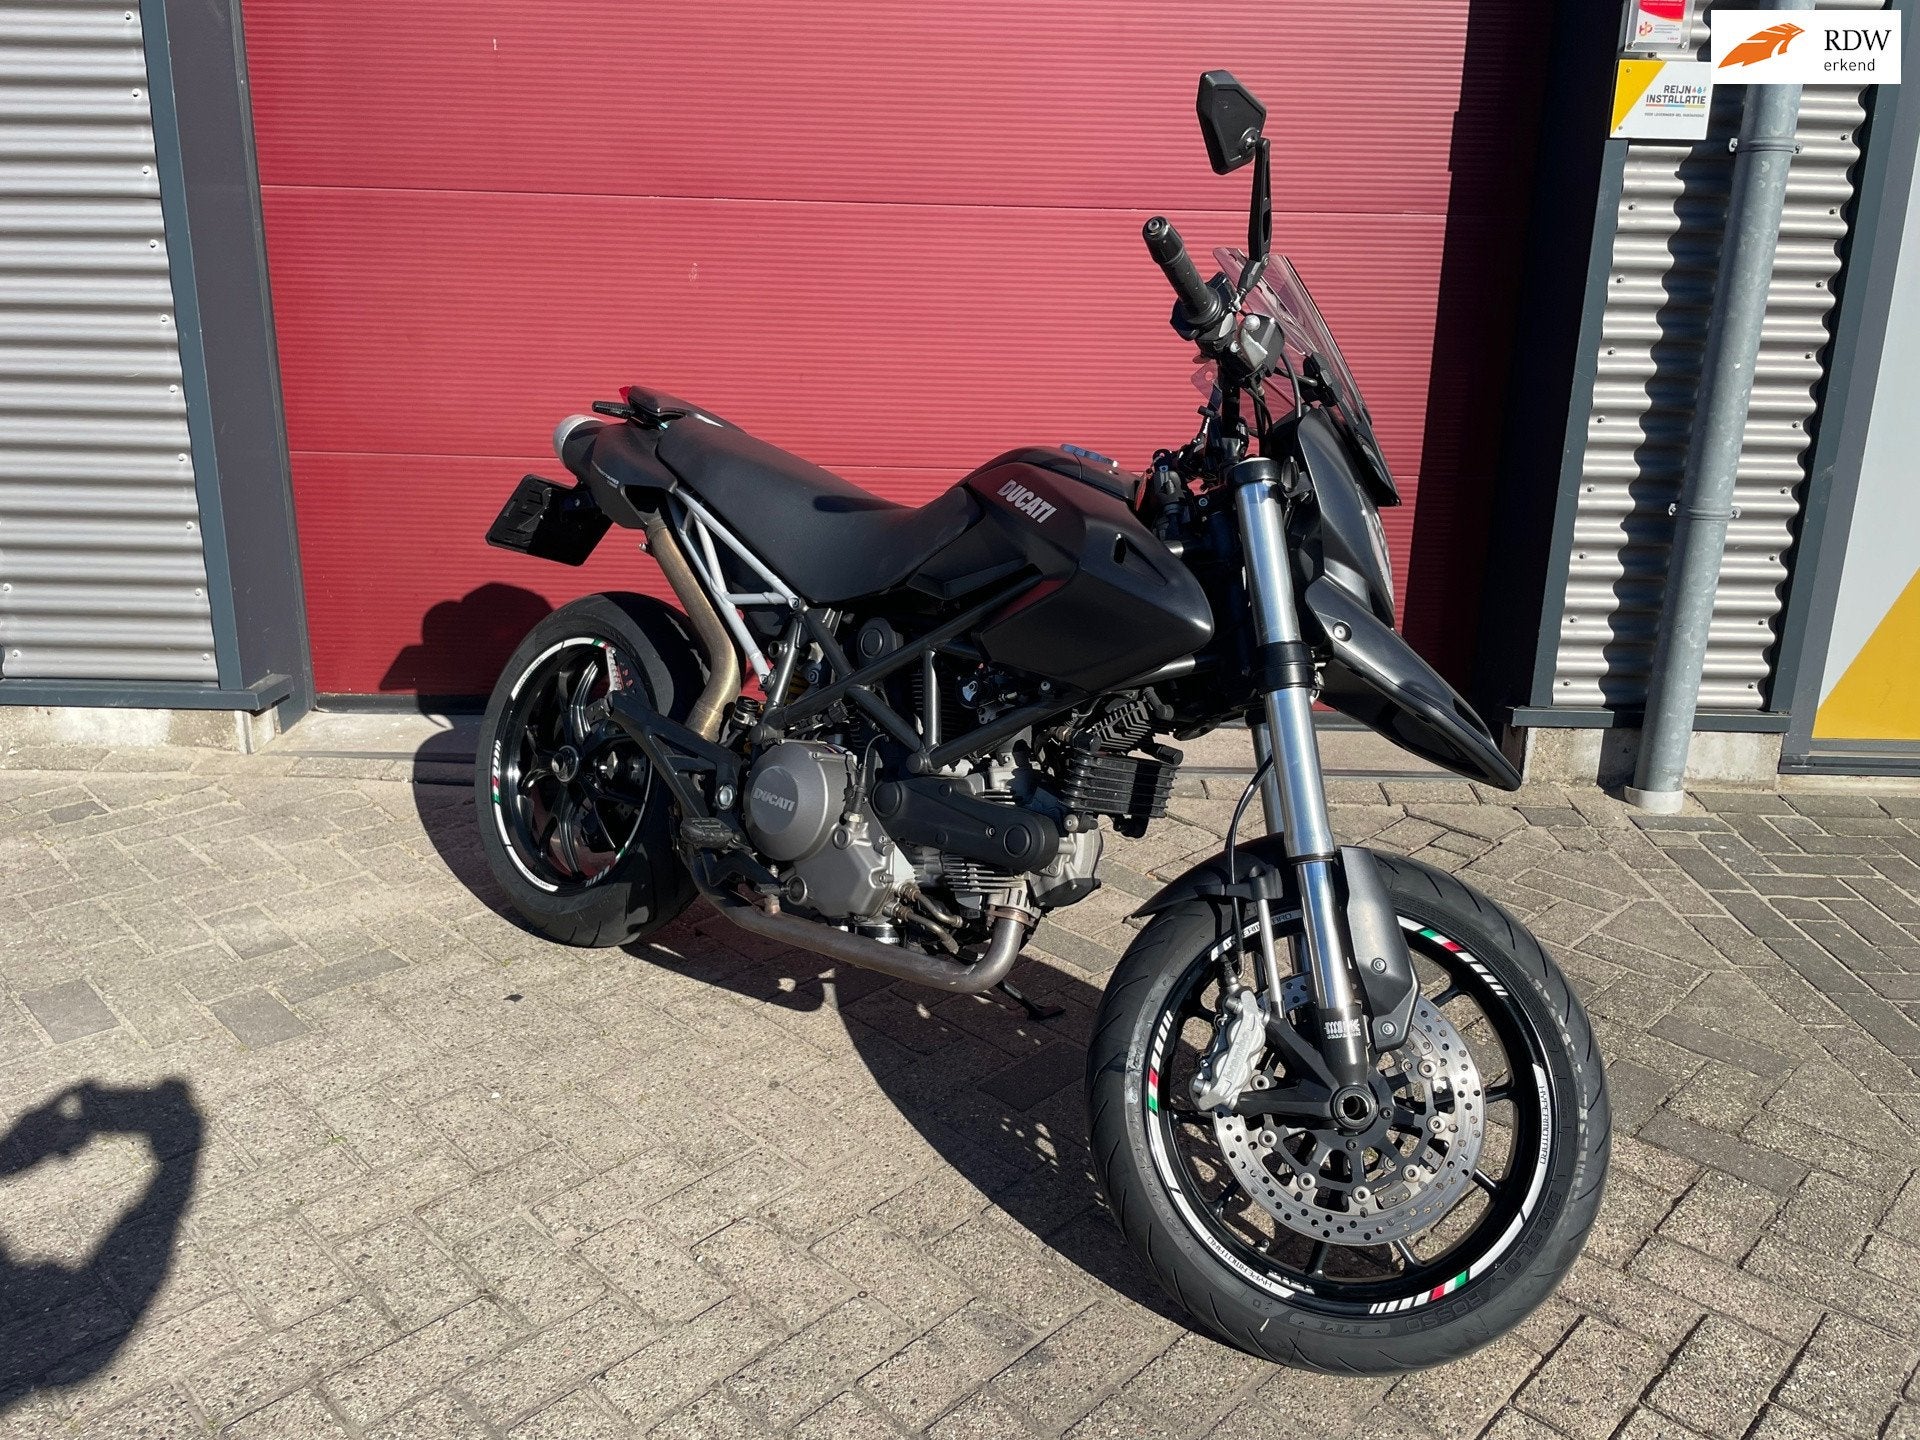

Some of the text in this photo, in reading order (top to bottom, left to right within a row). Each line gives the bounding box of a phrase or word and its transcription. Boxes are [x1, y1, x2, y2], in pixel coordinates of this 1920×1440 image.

[1646, 94, 1706, 104] INSTALLATIE
[1663, 85, 1691, 94] REIJN
[997, 479, 1057, 523] DUCATI
[753, 788, 795, 811] DUCATI
[1207, 1236, 1272, 1288] HYPERMOTARD
[1405, 1292, 1484, 1332] ROSSO
